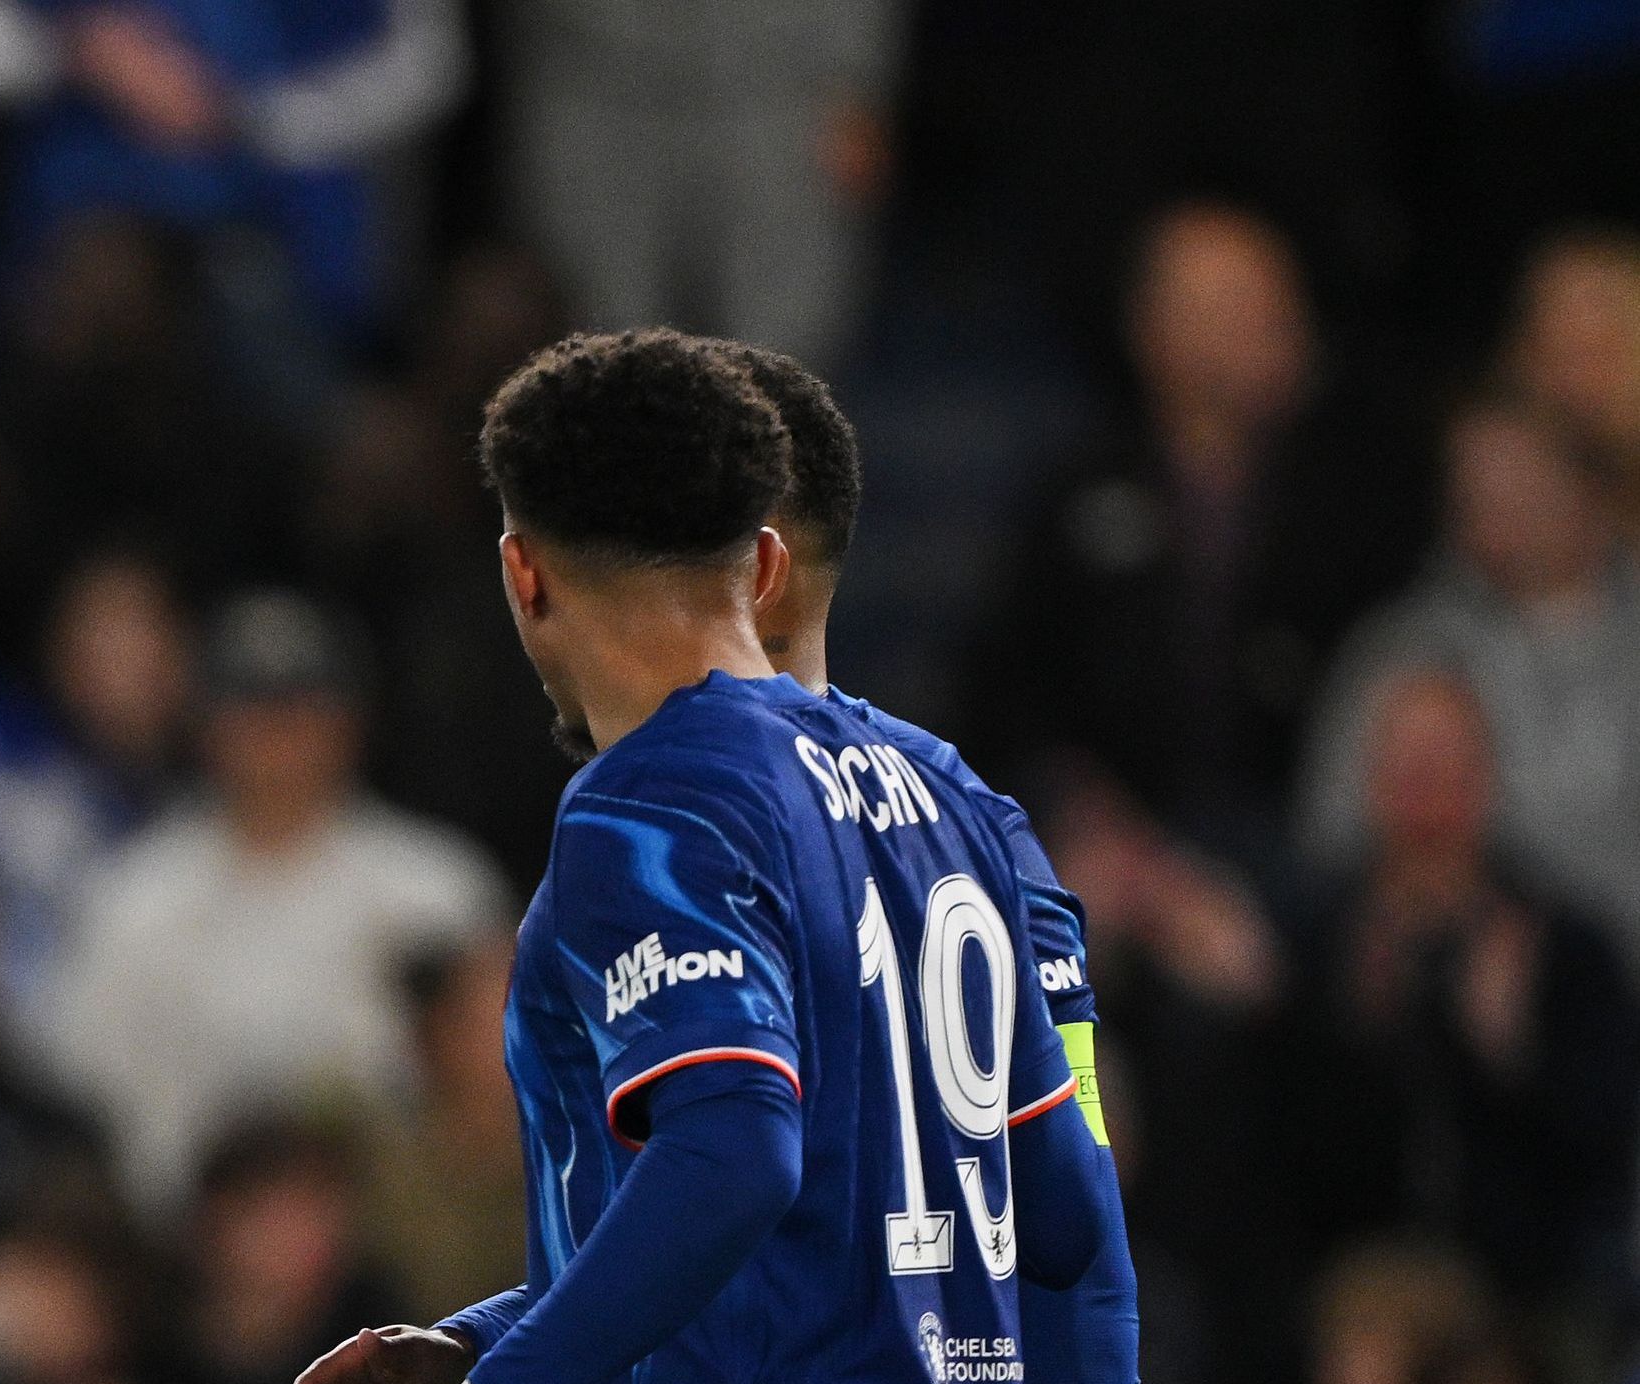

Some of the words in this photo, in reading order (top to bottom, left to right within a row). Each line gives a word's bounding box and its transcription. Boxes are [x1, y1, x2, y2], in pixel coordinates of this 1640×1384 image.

[605, 931, 666, 996] LIVE
[606, 949, 744, 1023] NATION
[856, 873, 1018, 1281] 19
